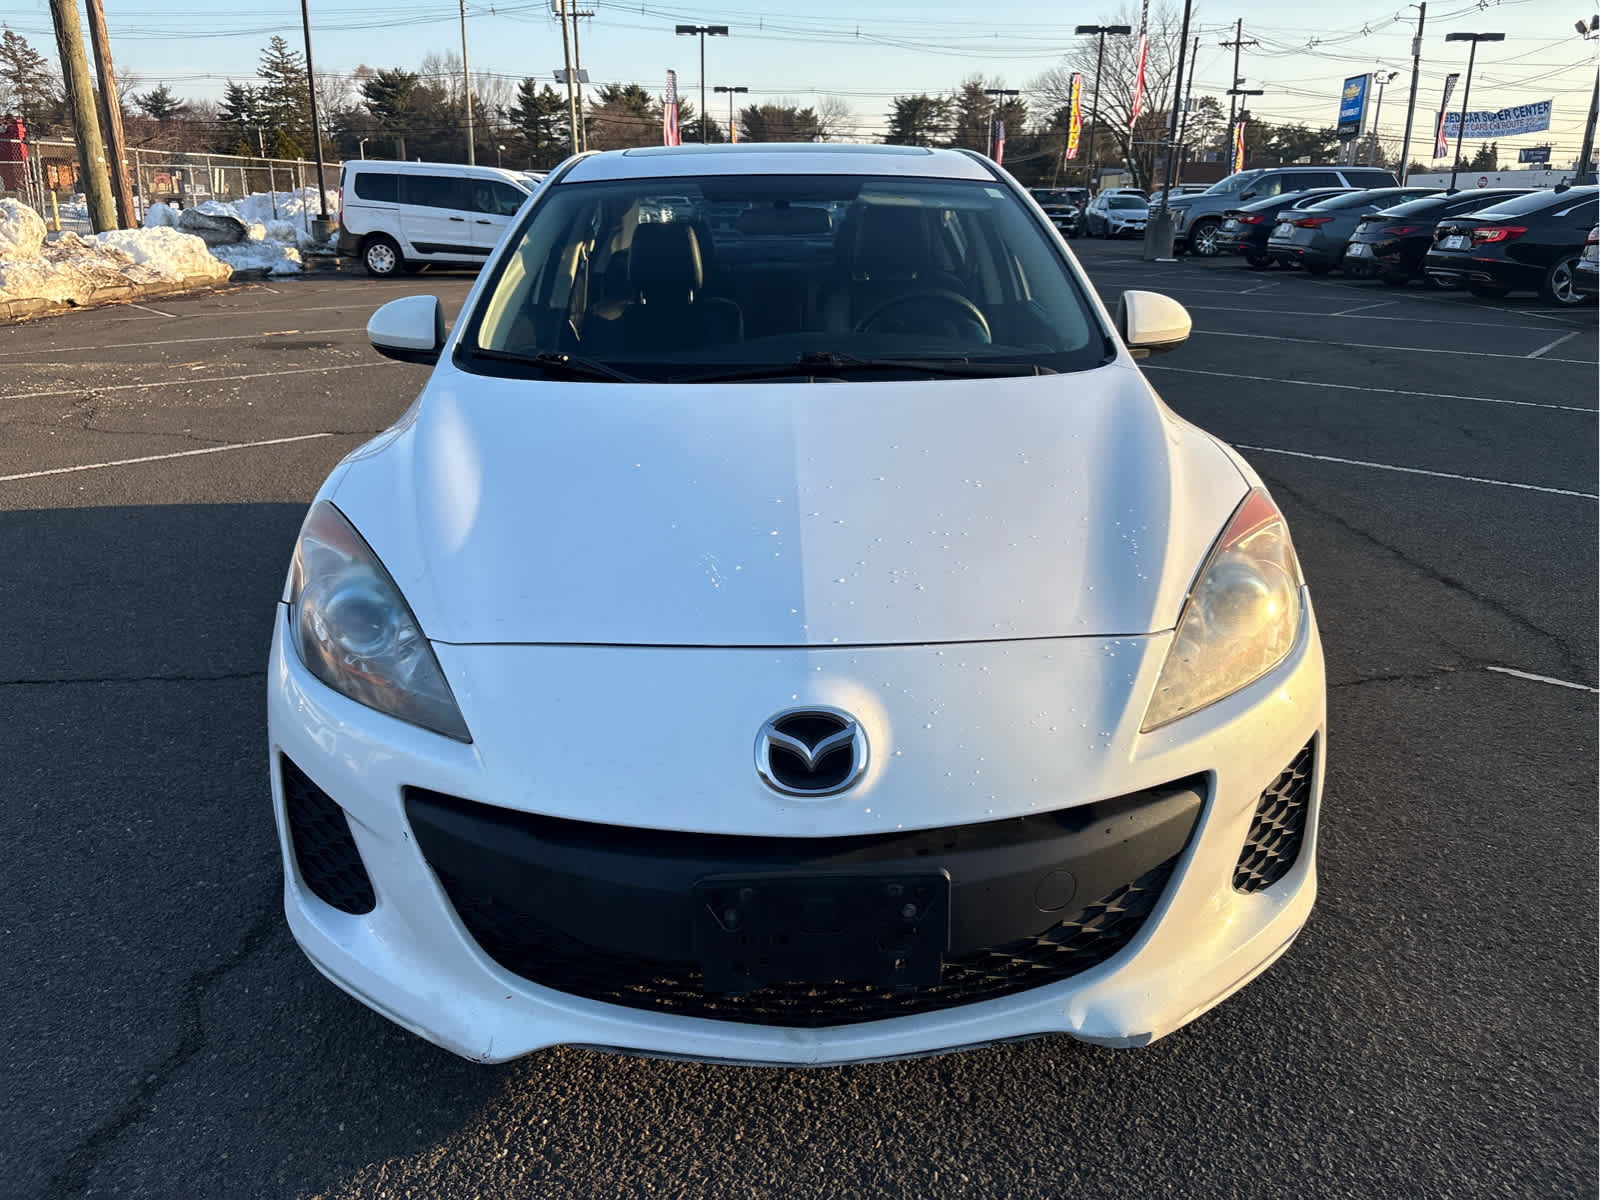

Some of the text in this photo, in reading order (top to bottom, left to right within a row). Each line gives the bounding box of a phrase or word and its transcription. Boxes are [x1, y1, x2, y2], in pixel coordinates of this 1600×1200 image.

[1464, 112, 1480, 123] CAR
[1482, 109, 1512, 123] SUPER
[1513, 102, 1549, 119] CENTER
[1501, 119, 1524, 129] ROUTE
